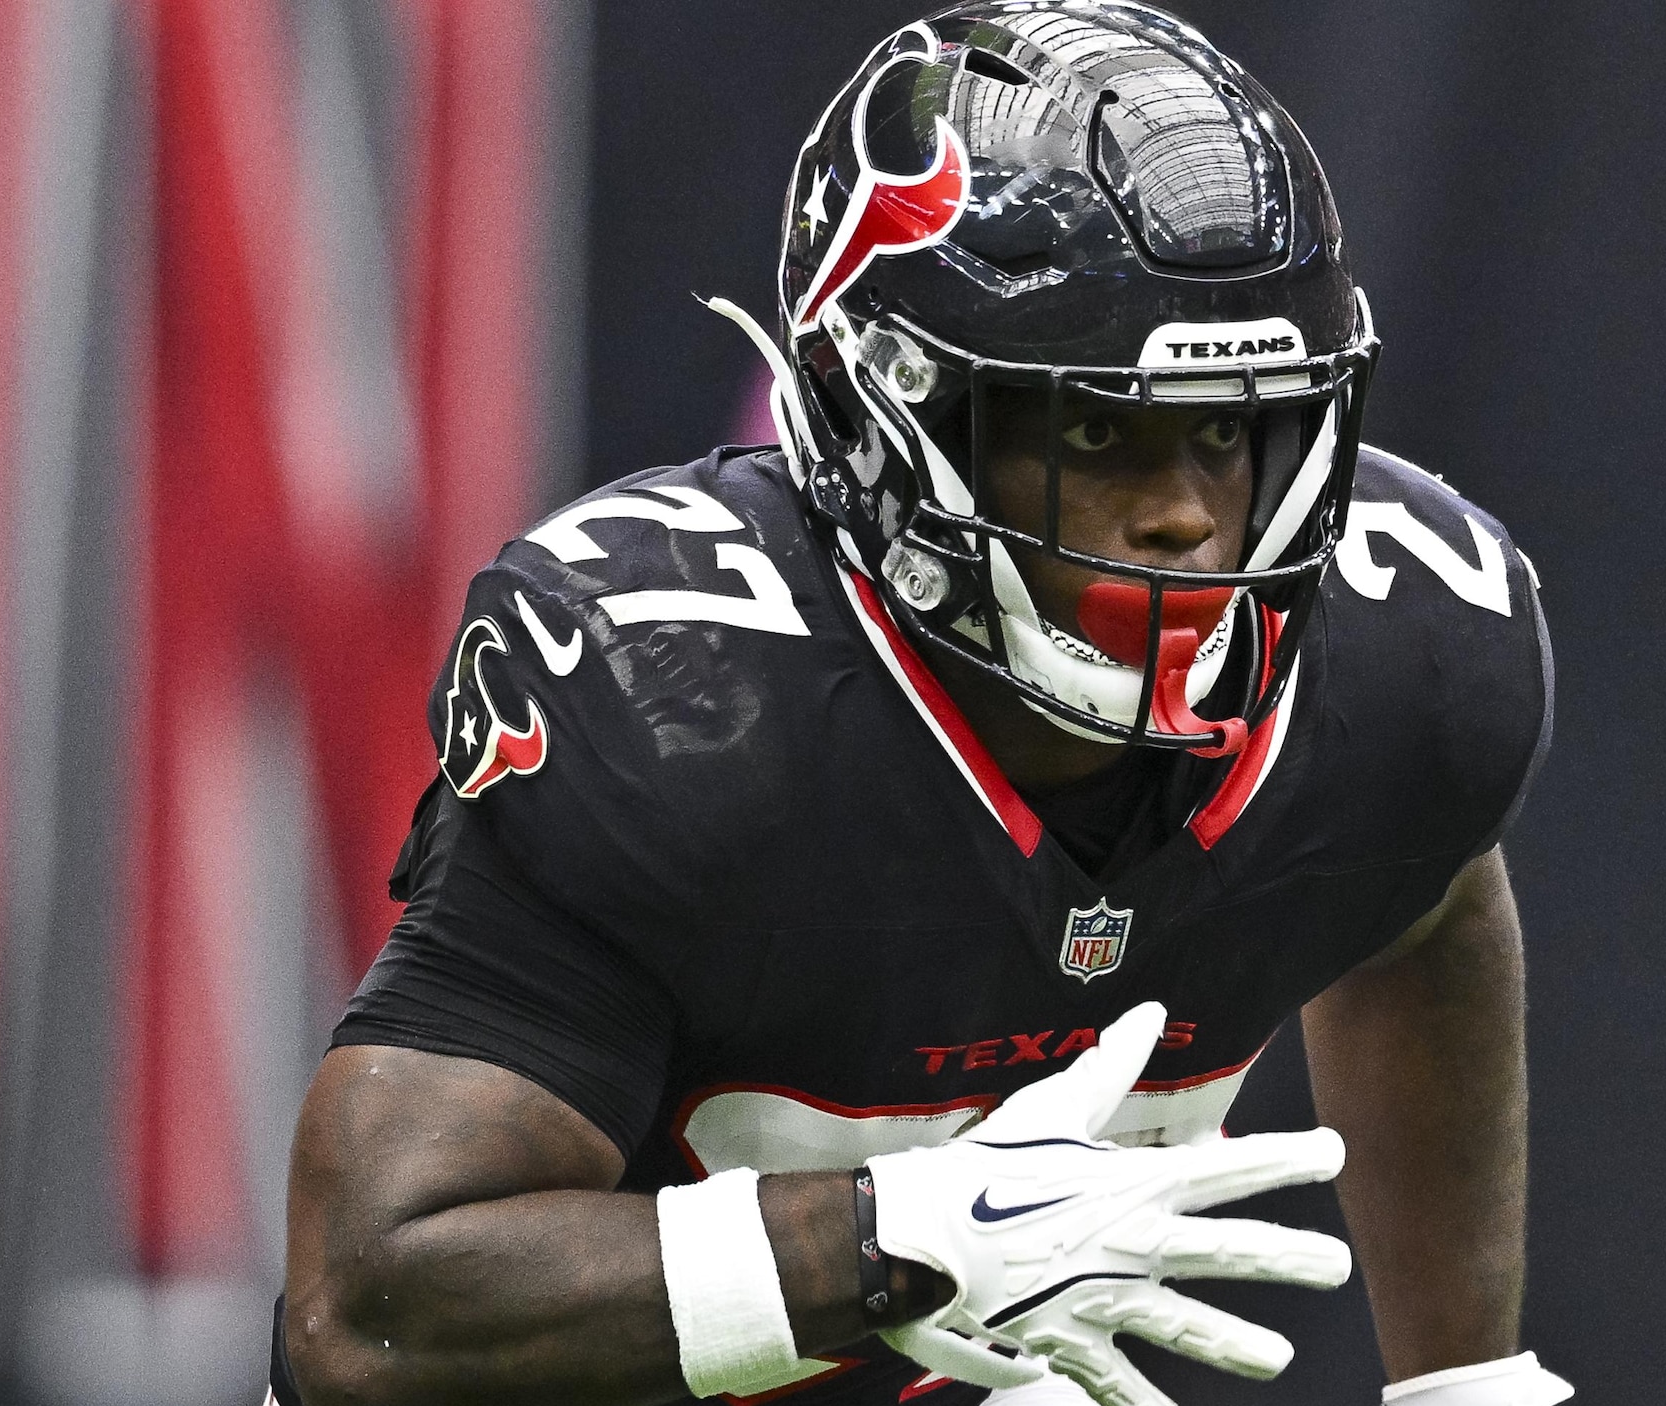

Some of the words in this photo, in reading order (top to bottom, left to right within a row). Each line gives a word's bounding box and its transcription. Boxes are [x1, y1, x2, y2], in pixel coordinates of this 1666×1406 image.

[1165, 336, 1295, 359] TEXANS
[1334, 441, 1512, 618] 2
[525, 486, 812, 636] 27
[1069, 939, 1114, 969] NFL
[914, 1021, 1197, 1075] TEXAS
